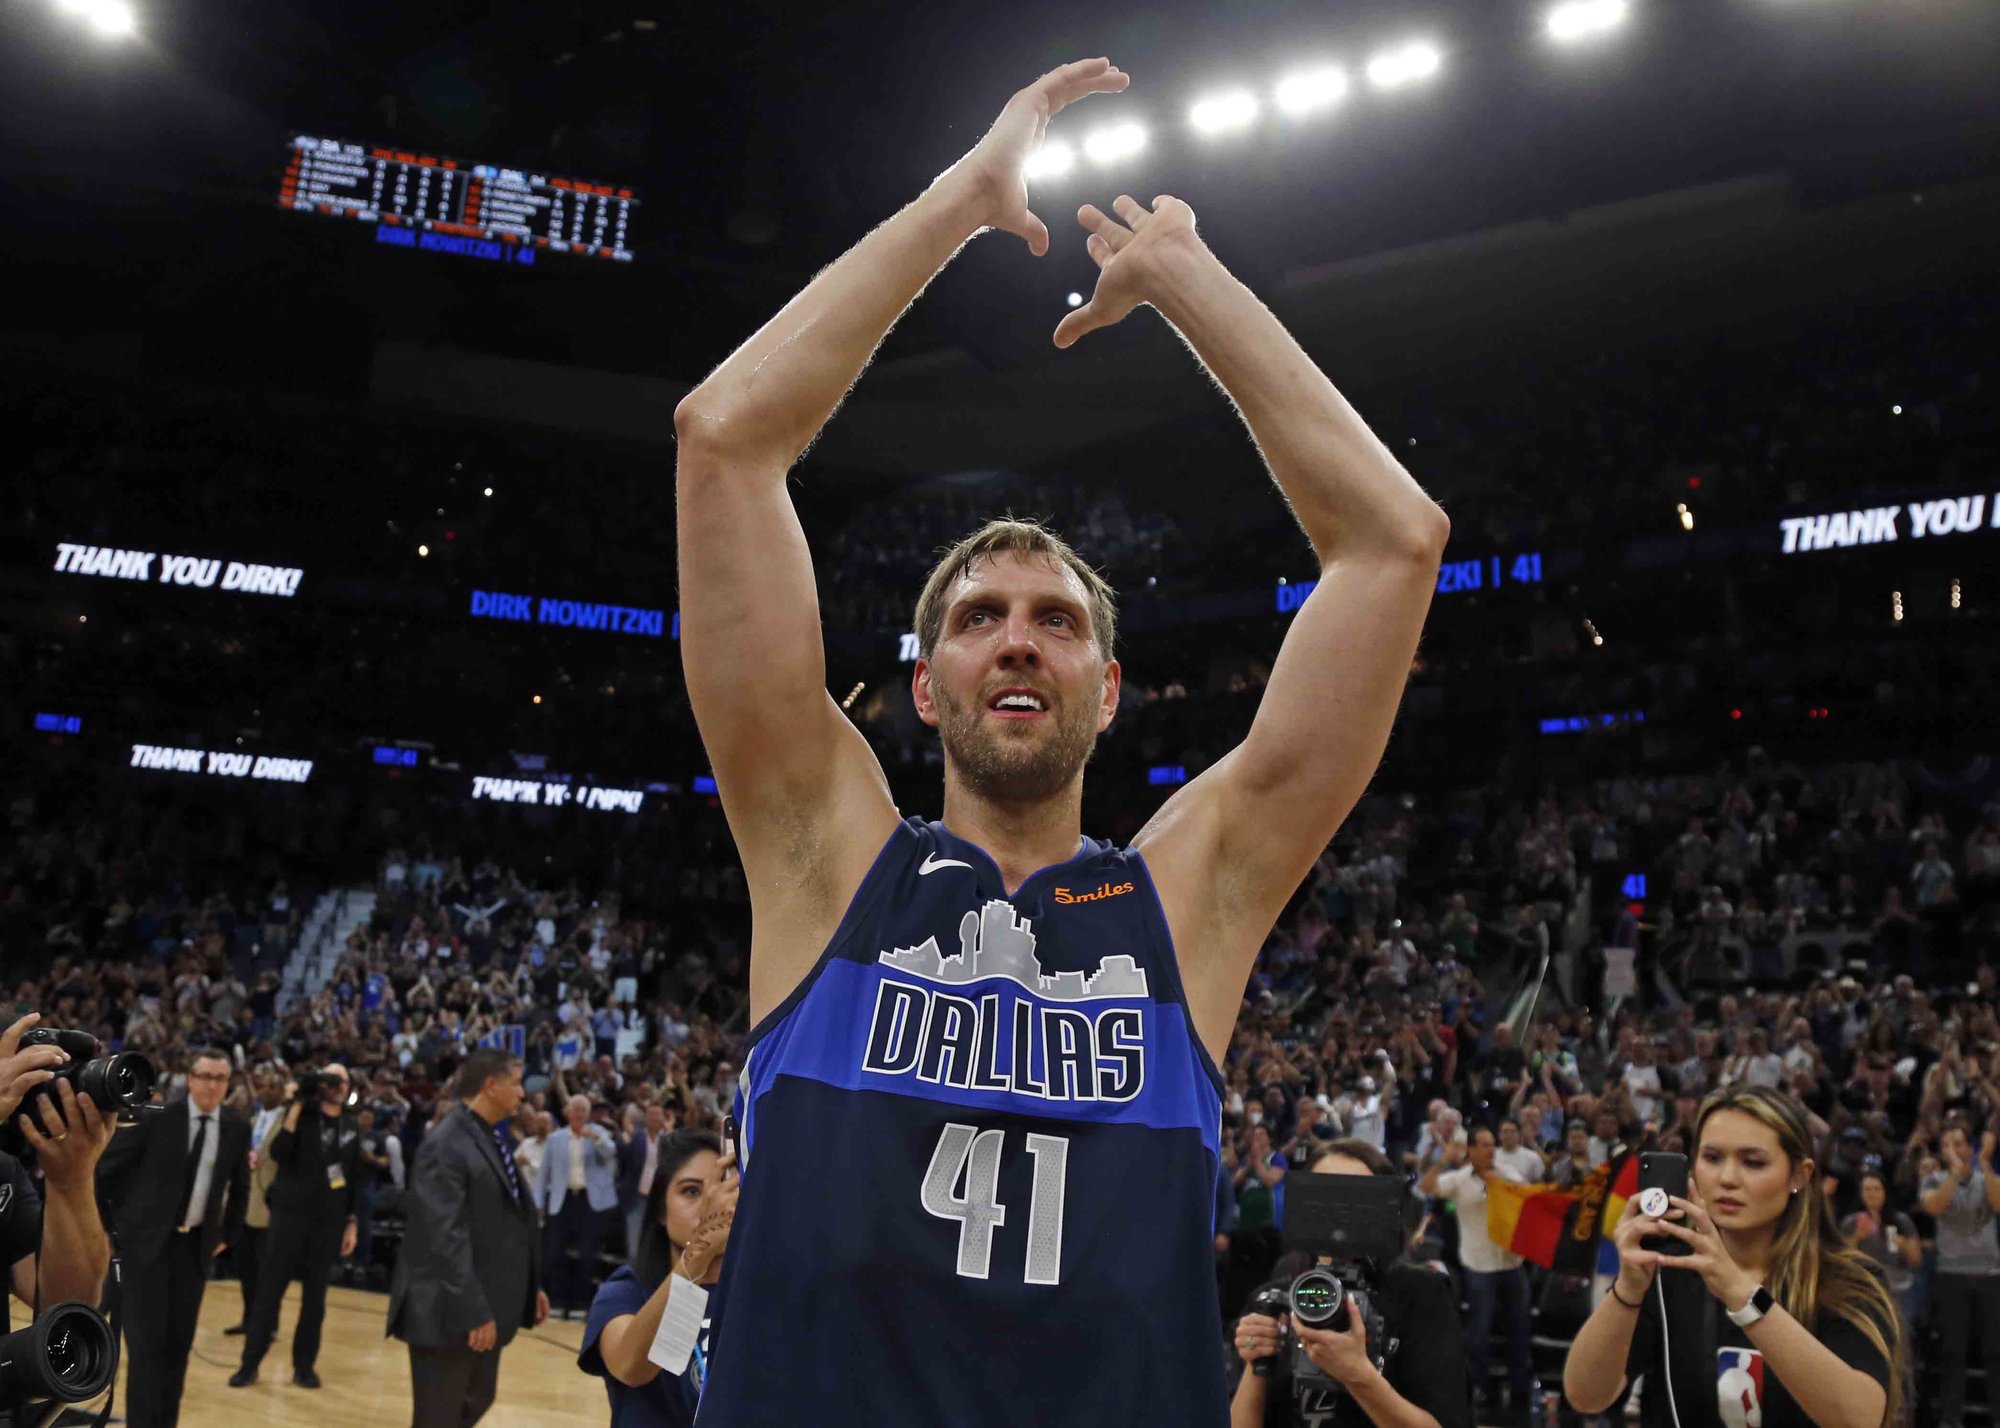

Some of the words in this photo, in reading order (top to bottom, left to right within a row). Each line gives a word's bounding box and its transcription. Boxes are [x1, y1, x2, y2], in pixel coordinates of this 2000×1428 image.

[1780, 505, 1901, 554] THANK
[1908, 494, 1986, 538] YOU
[54, 542, 155, 581] THANK
[159, 554, 221, 588] YOU
[221, 562, 303, 597] DIRK!
[1510, 552, 1542, 583] 41
[470, 590, 532, 622] DIRK
[537, 598, 663, 636] NOWITZKI
[130, 744, 205, 773] THANK
[206, 751, 253, 777] YOU
[251, 756, 313, 783] DIRK!
[1055, 882, 1134, 904] 5miles
[1622, 873, 1646, 899] 41
[862, 978, 1144, 1102] DALLAS
[920, 1122, 1069, 1286] 41
